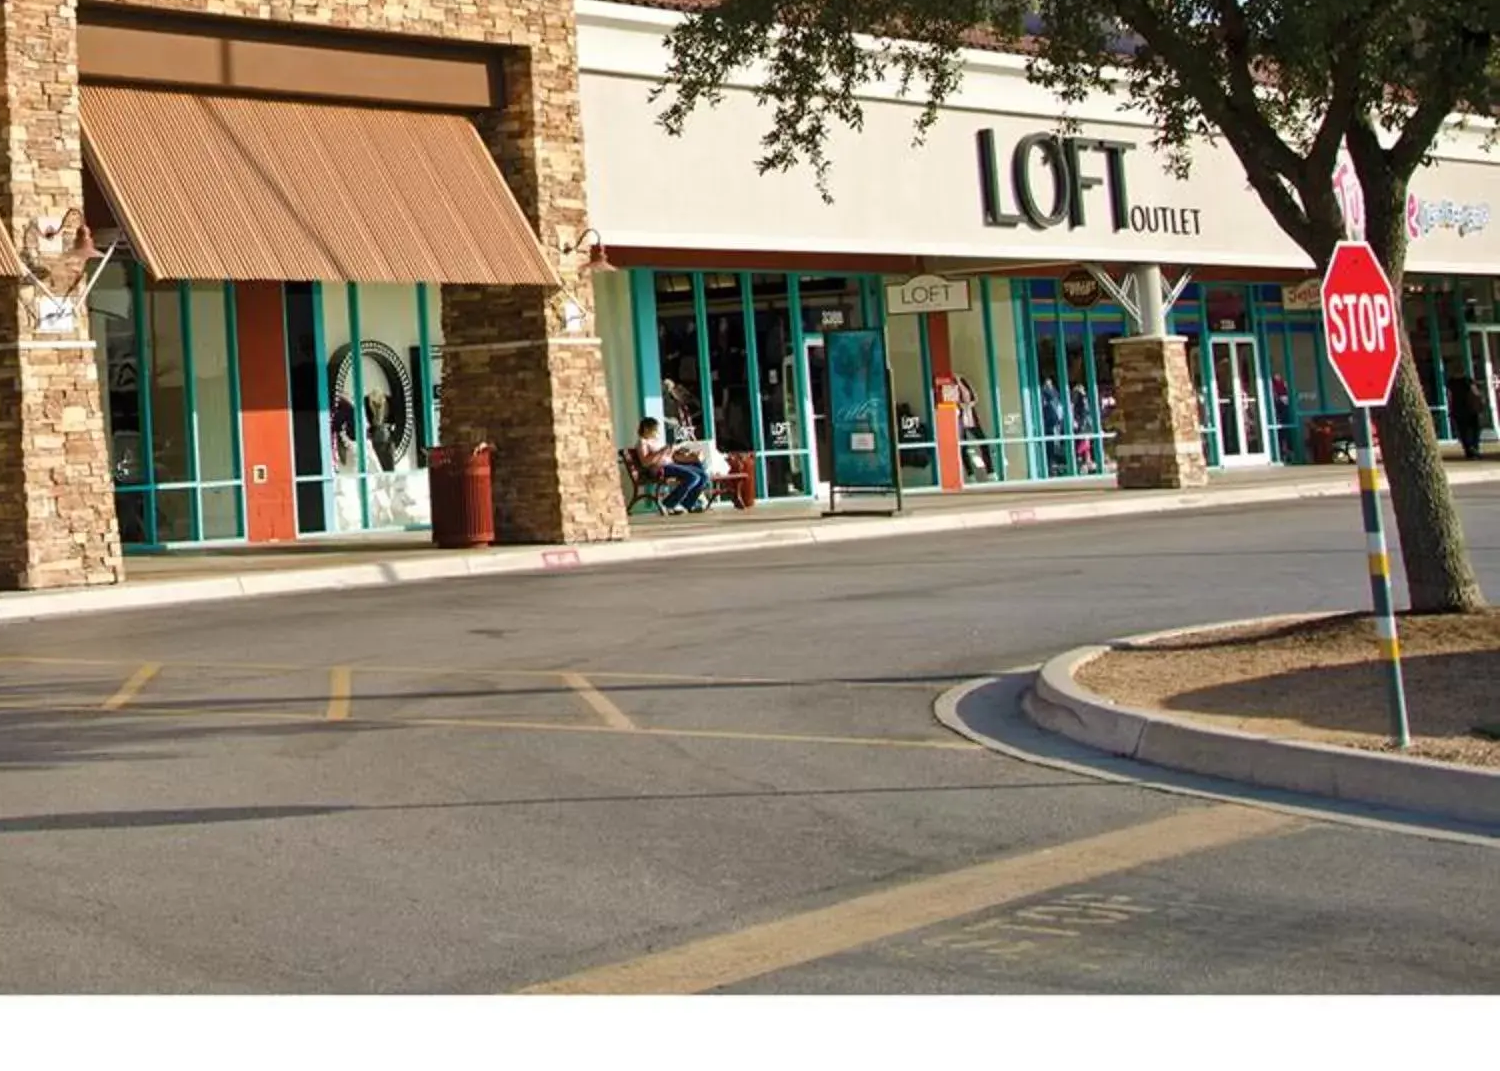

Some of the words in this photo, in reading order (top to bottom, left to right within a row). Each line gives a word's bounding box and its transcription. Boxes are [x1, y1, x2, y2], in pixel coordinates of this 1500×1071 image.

[976, 128, 1137, 233] LOFT
[1131, 205, 1201, 236] OUTLET
[901, 284, 953, 305] LOFT
[1329, 293, 1391, 354] STOP
